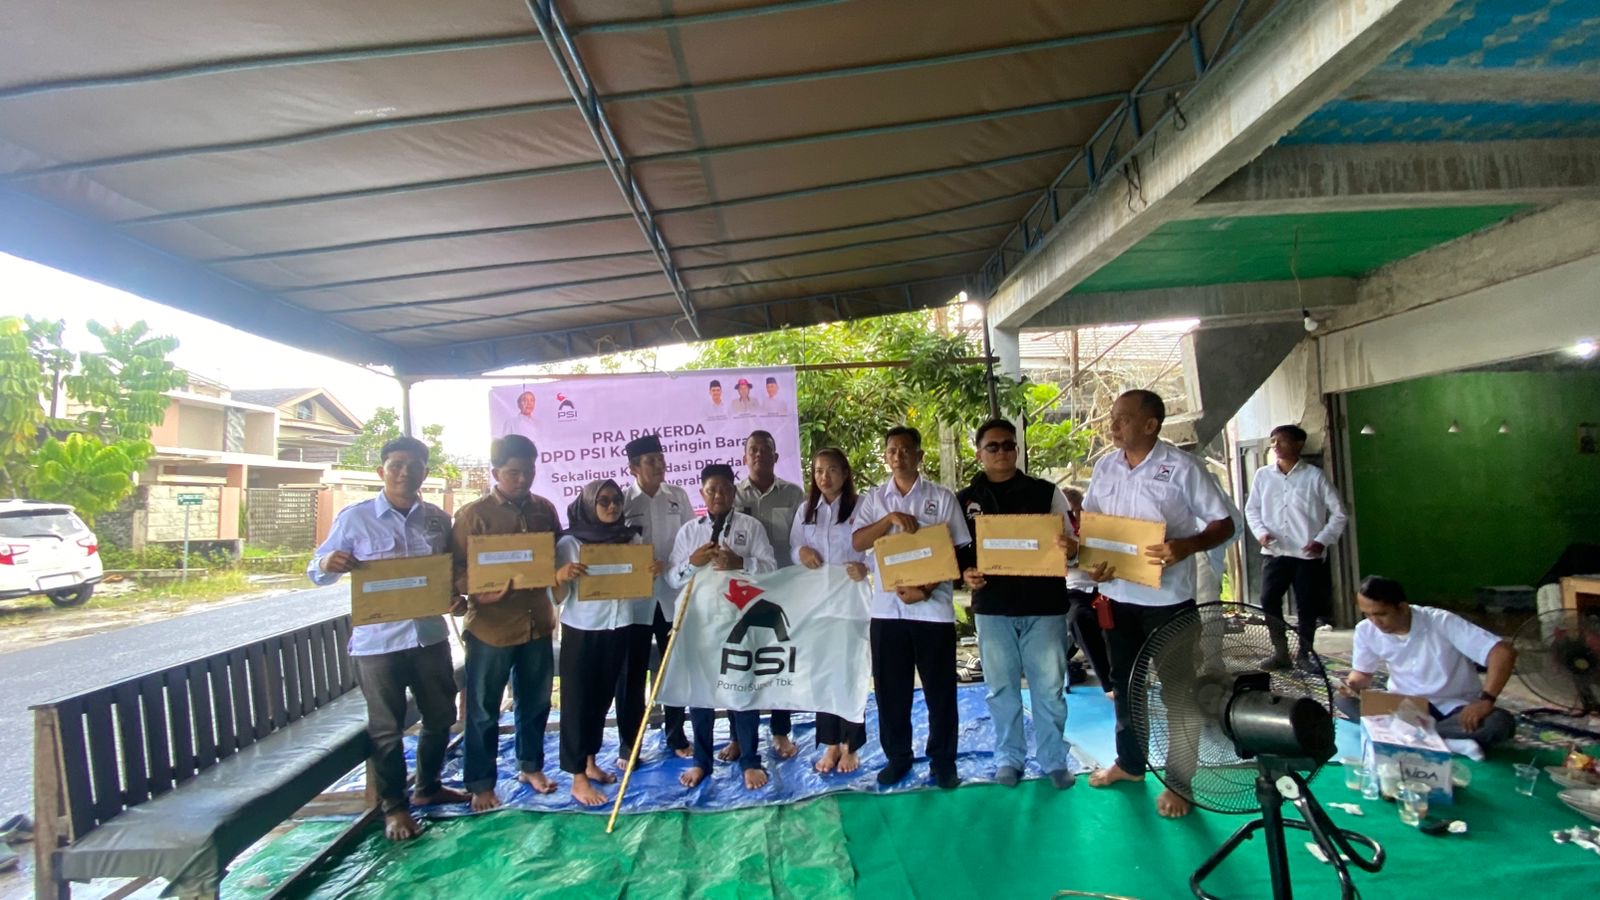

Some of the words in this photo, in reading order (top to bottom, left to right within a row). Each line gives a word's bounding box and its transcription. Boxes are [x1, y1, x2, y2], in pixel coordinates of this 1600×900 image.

[592, 430, 626, 444] PRA
[630, 424, 705, 441] RAKERDA
[541, 449, 576, 464] DPD
[580, 446, 606, 461] PSI
[610, 439, 711, 457] Koaringin
[715, 436, 749, 449] Bara
[551, 469, 617, 483] Sekaligus
[720, 647, 796, 675] PSI
[716, 680, 748, 692] Partai
